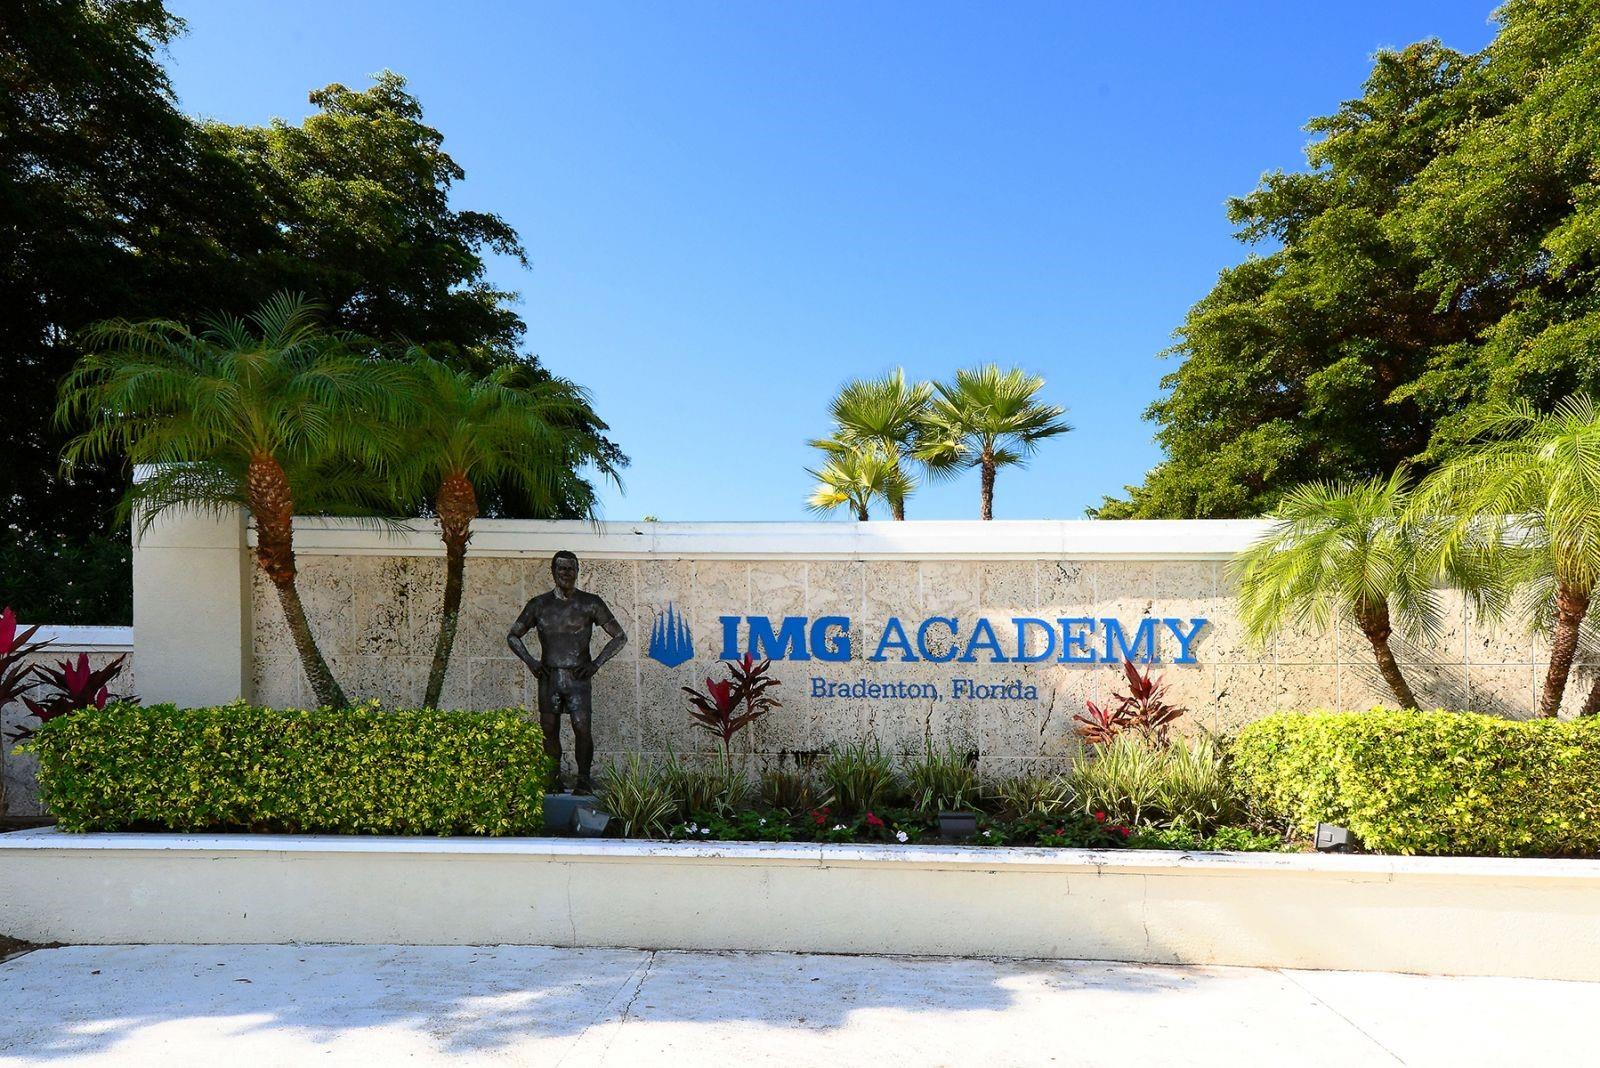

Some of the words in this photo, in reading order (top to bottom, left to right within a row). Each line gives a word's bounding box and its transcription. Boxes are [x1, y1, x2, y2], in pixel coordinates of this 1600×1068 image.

[719, 616, 851, 663] IMG
[870, 617, 1208, 665] ACADEMY
[811, 677, 943, 703] Bradenton,
[953, 678, 1038, 701] Florida
